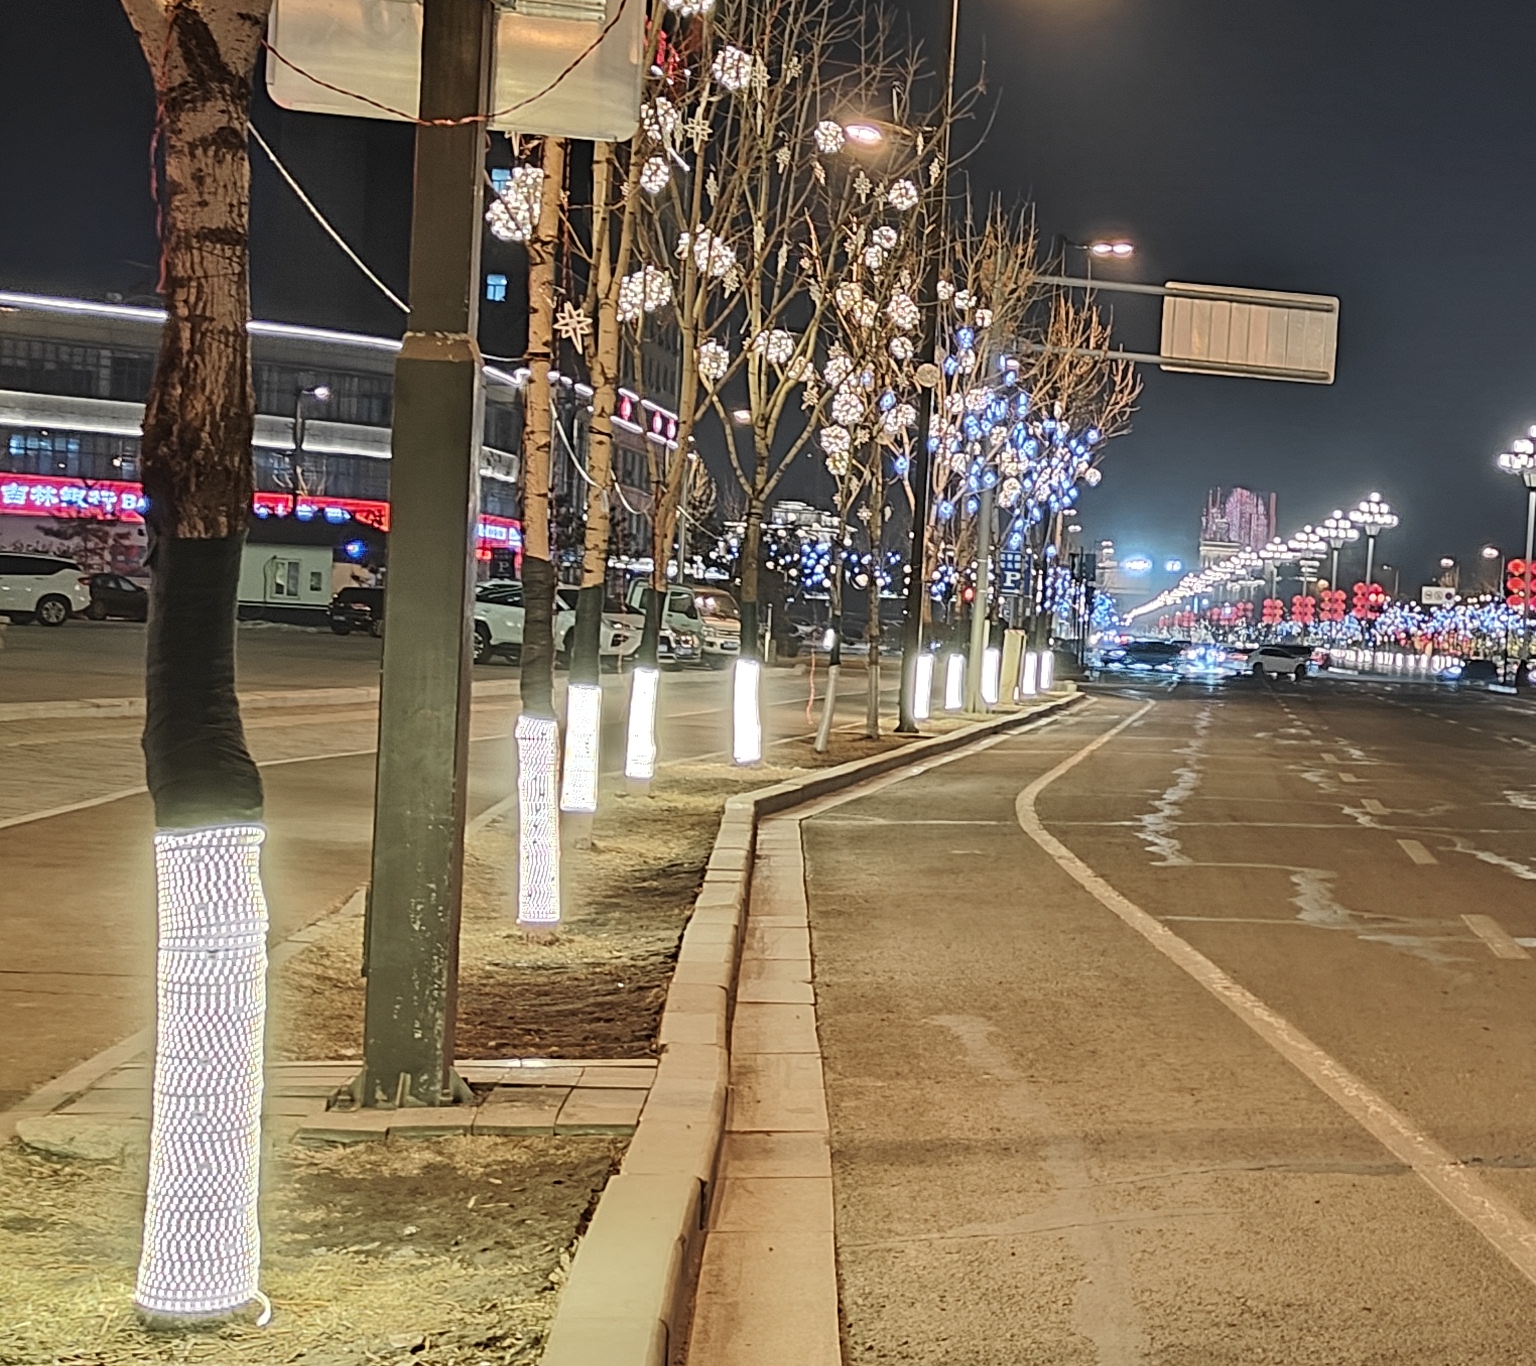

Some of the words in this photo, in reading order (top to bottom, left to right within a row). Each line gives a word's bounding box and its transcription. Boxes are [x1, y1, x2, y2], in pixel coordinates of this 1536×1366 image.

[1, 482, 118, 512] 吉林银行
[120, 493, 149, 510] BA
[498, 560, 510, 573] P
[1003, 570, 1021, 587] P
